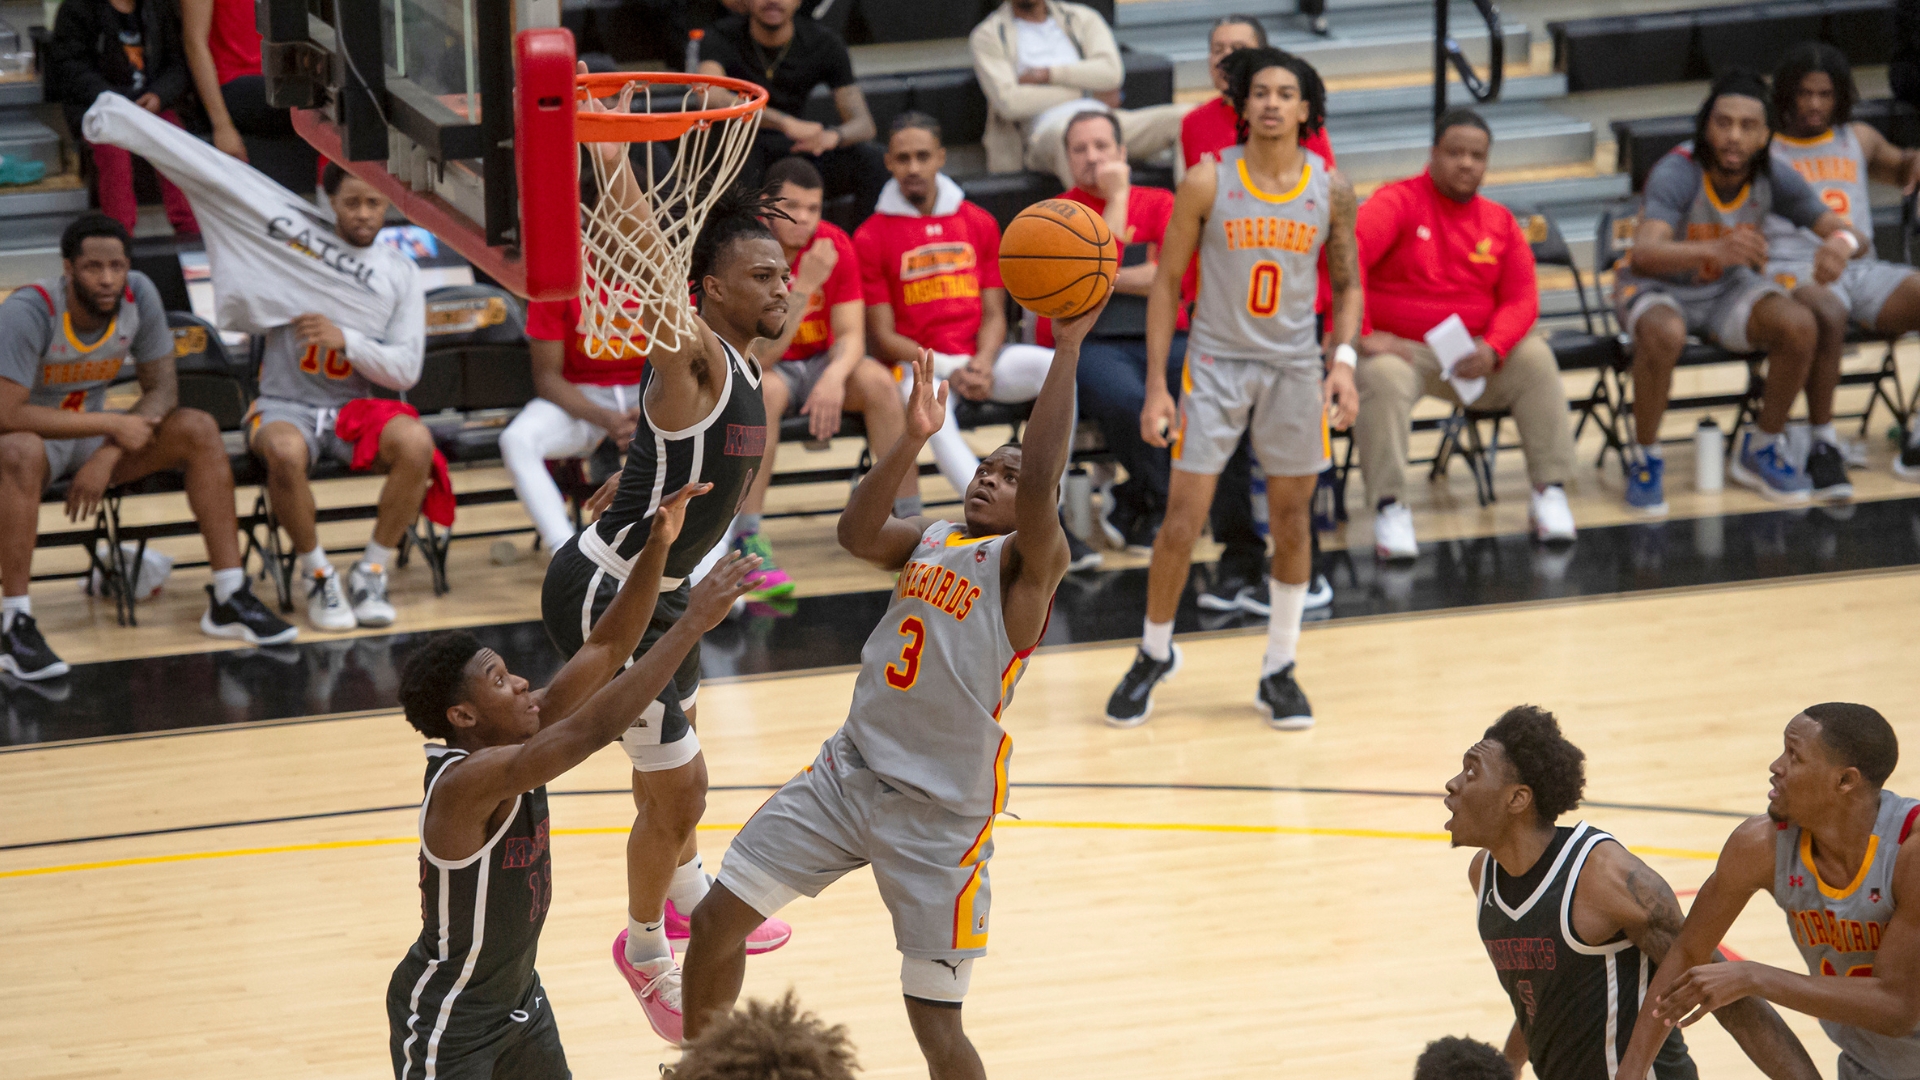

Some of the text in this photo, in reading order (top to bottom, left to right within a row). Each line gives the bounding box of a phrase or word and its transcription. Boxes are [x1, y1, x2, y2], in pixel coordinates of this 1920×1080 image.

[1223, 215, 1318, 255] FIREBIRDS
[1246, 259, 1283, 318] 0
[883, 614, 926, 693] 3
